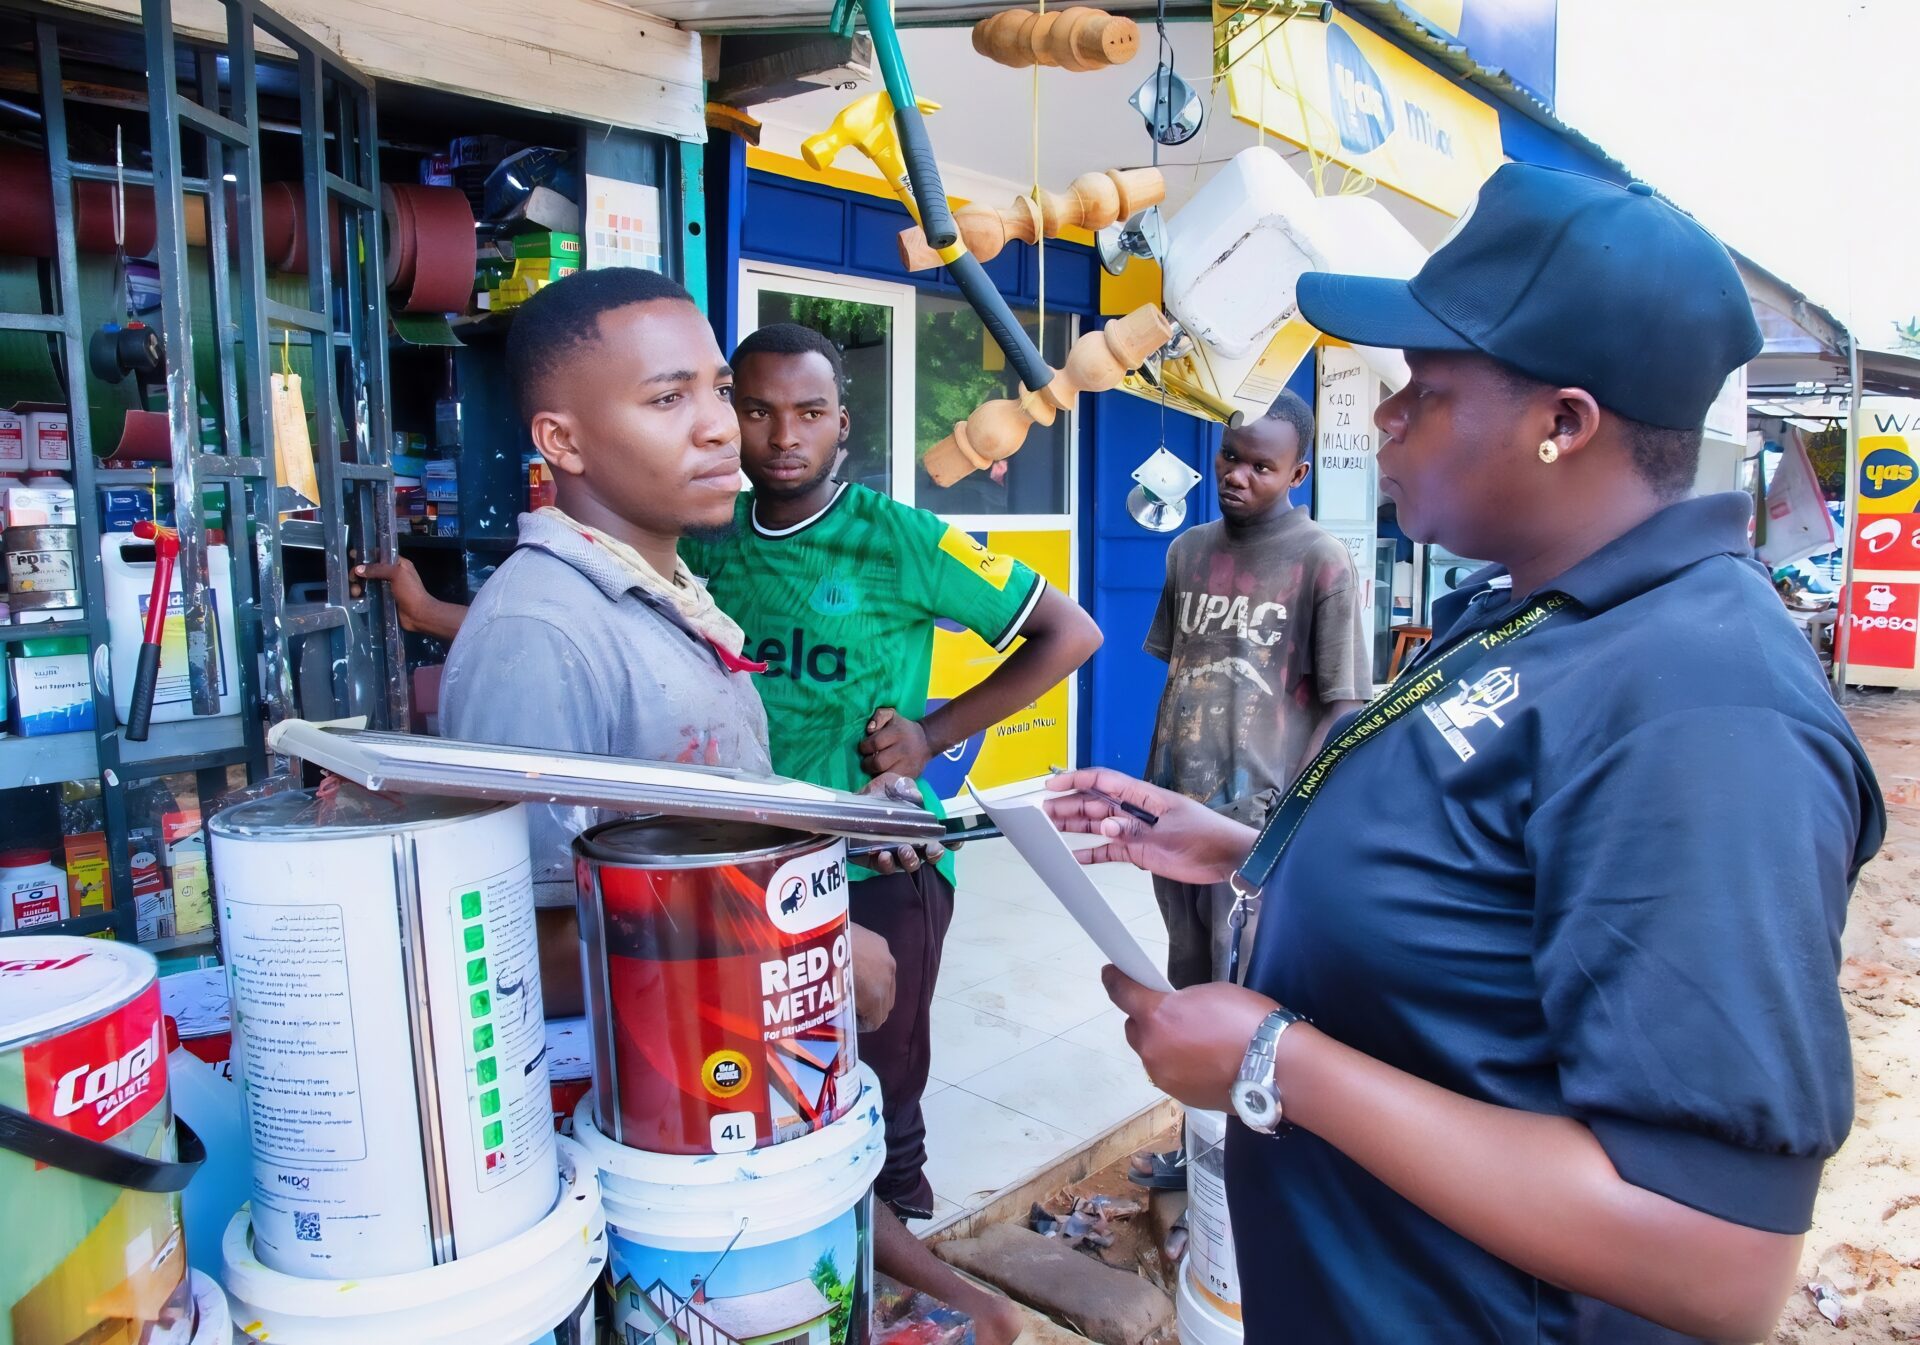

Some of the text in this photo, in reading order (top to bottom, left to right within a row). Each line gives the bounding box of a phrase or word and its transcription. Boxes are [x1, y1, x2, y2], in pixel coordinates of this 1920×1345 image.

[1336, 412, 1350, 426] ZA
[1323, 433, 1370, 451] MIALIKO
[1866, 464, 1912, 490] yas
[1176, 591, 1287, 646] UPAC
[1480, 606, 1547, 650] TANZANIA
[996, 717, 1057, 737] Wakala Mkuu
[1297, 749, 1341, 799] TANZANIA
[1339, 714, 1386, 749] REVENUE
[1383, 669, 1444, 719] AUTHORITY
[760, 934, 850, 997] RED O
[762, 976, 841, 1027] METAL
[53, 1020, 160, 1117] Coral
[721, 1124, 746, 1141] 4L
